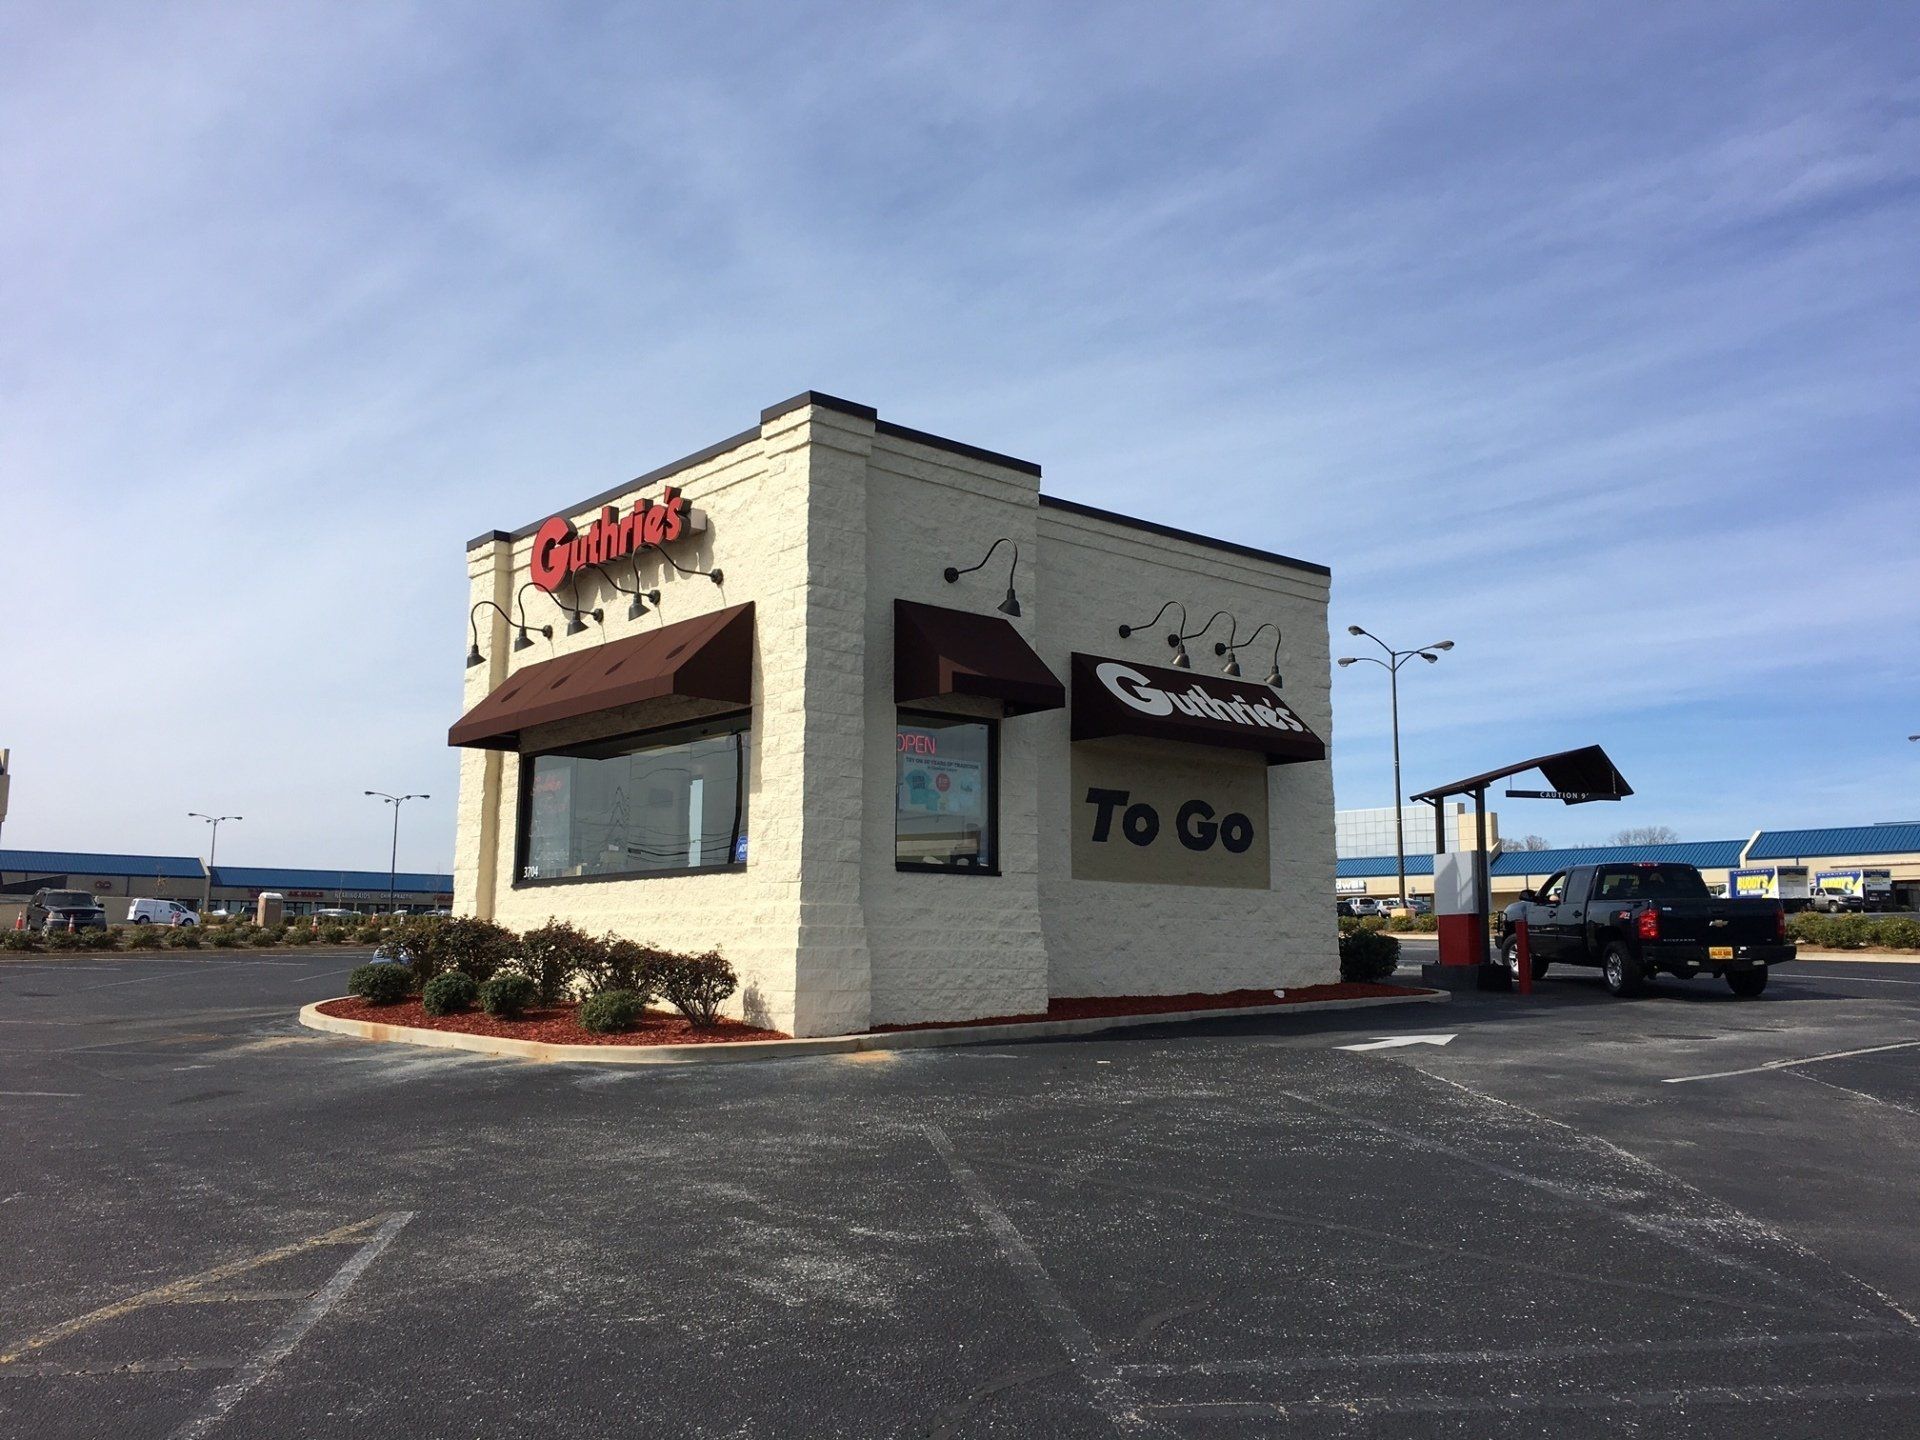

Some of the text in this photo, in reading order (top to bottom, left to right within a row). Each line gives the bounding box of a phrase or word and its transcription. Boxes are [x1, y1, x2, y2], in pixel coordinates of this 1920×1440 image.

[530, 486, 688, 592] Guthrie's
[1096, 662, 1304, 732] Guthrie's
[896, 733, 936, 754] OPEN
[1540, 791, 1578, 799] CAUTION
[523, 866, 539, 878] 3704
